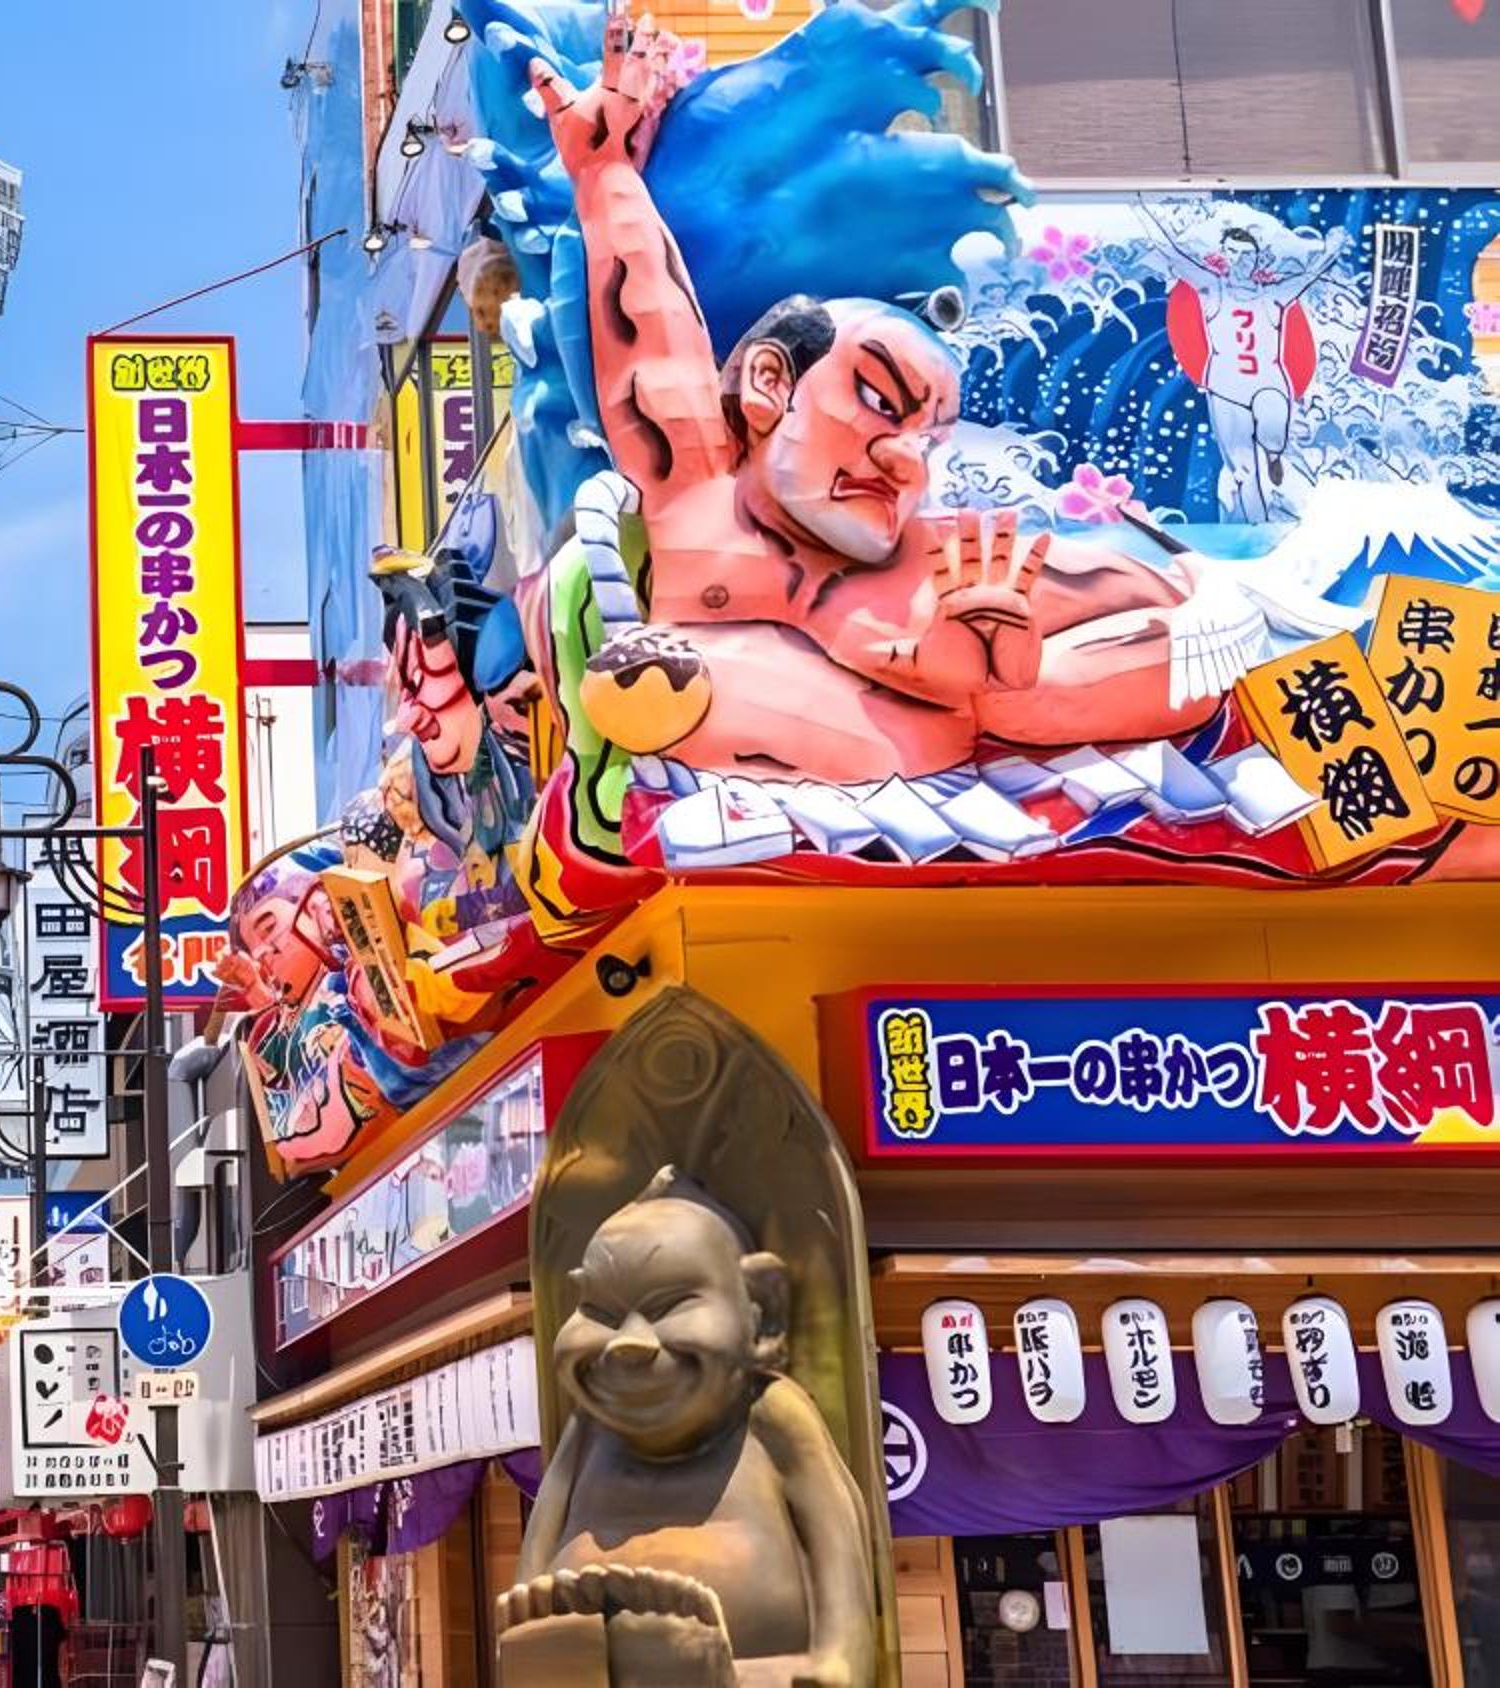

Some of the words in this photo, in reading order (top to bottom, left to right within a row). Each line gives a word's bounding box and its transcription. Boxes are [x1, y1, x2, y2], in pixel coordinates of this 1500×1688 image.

[136, 398, 198, 691] 日本一の串かつ
[1387, 598, 1455, 776] 串かつ
[936, 1032, 1250, 1110] 日本一の串かつ
[1256, 1005, 1494, 1131] 横綱
